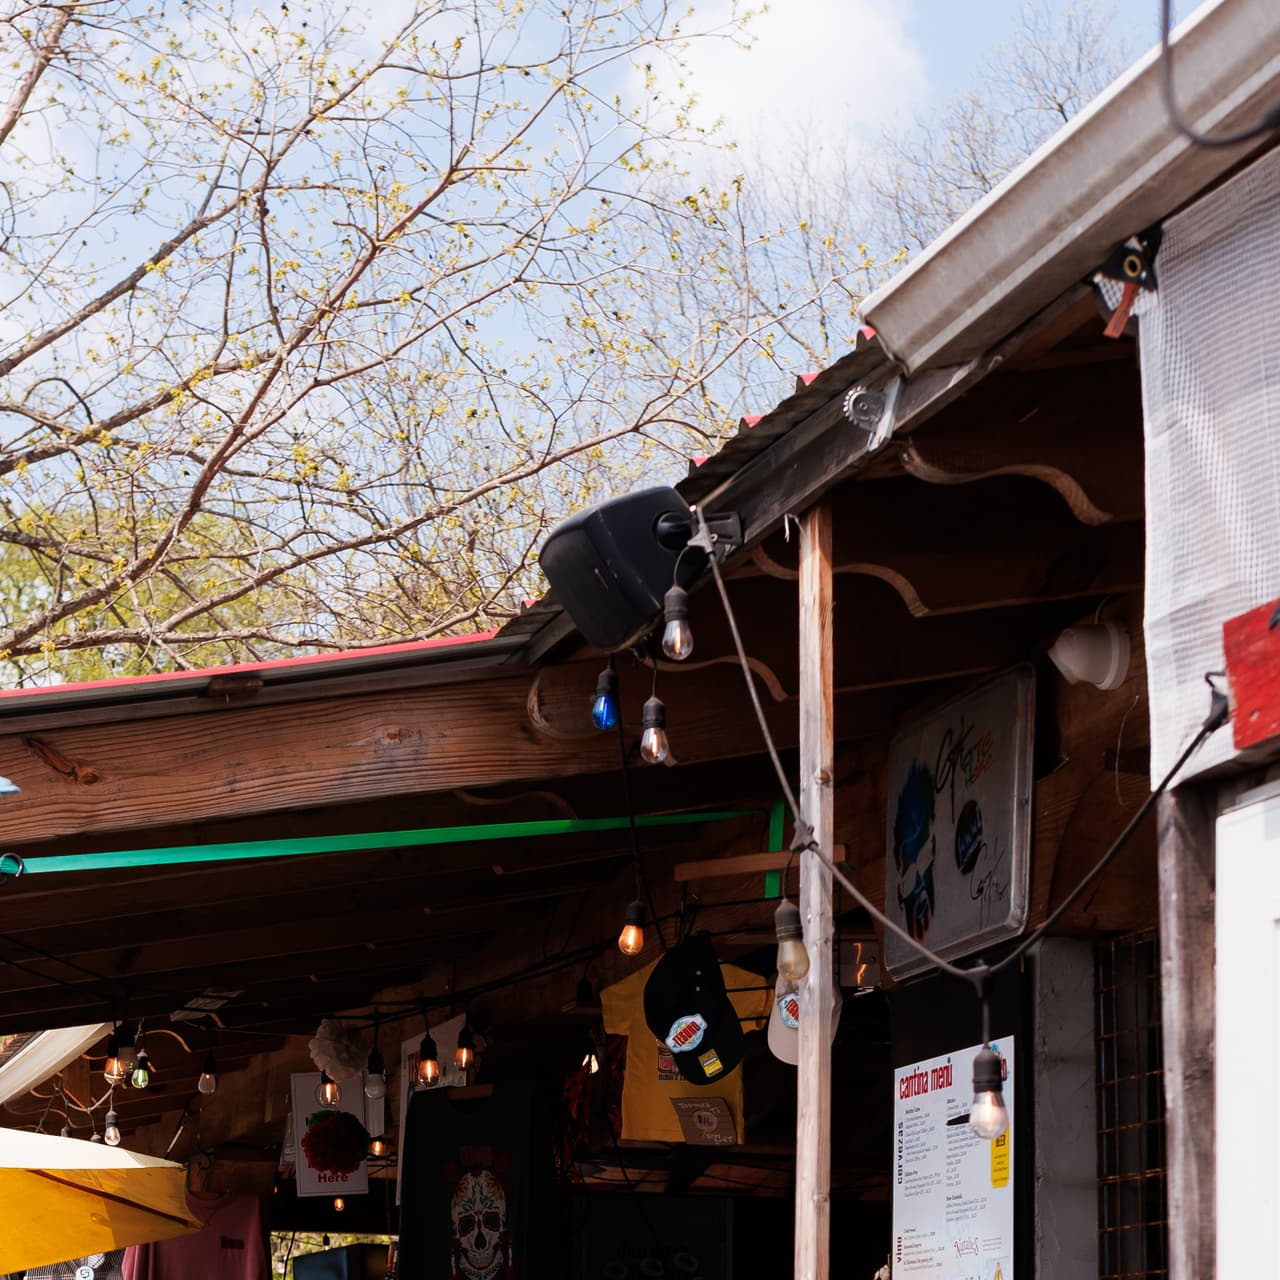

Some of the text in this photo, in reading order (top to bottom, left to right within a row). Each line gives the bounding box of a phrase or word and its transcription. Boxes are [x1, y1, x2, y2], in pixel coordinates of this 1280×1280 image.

[671, 1020, 702, 1047] TESORO
[899, 1065, 928, 1100] cantina
[318, 1173, 348, 1184] Here
